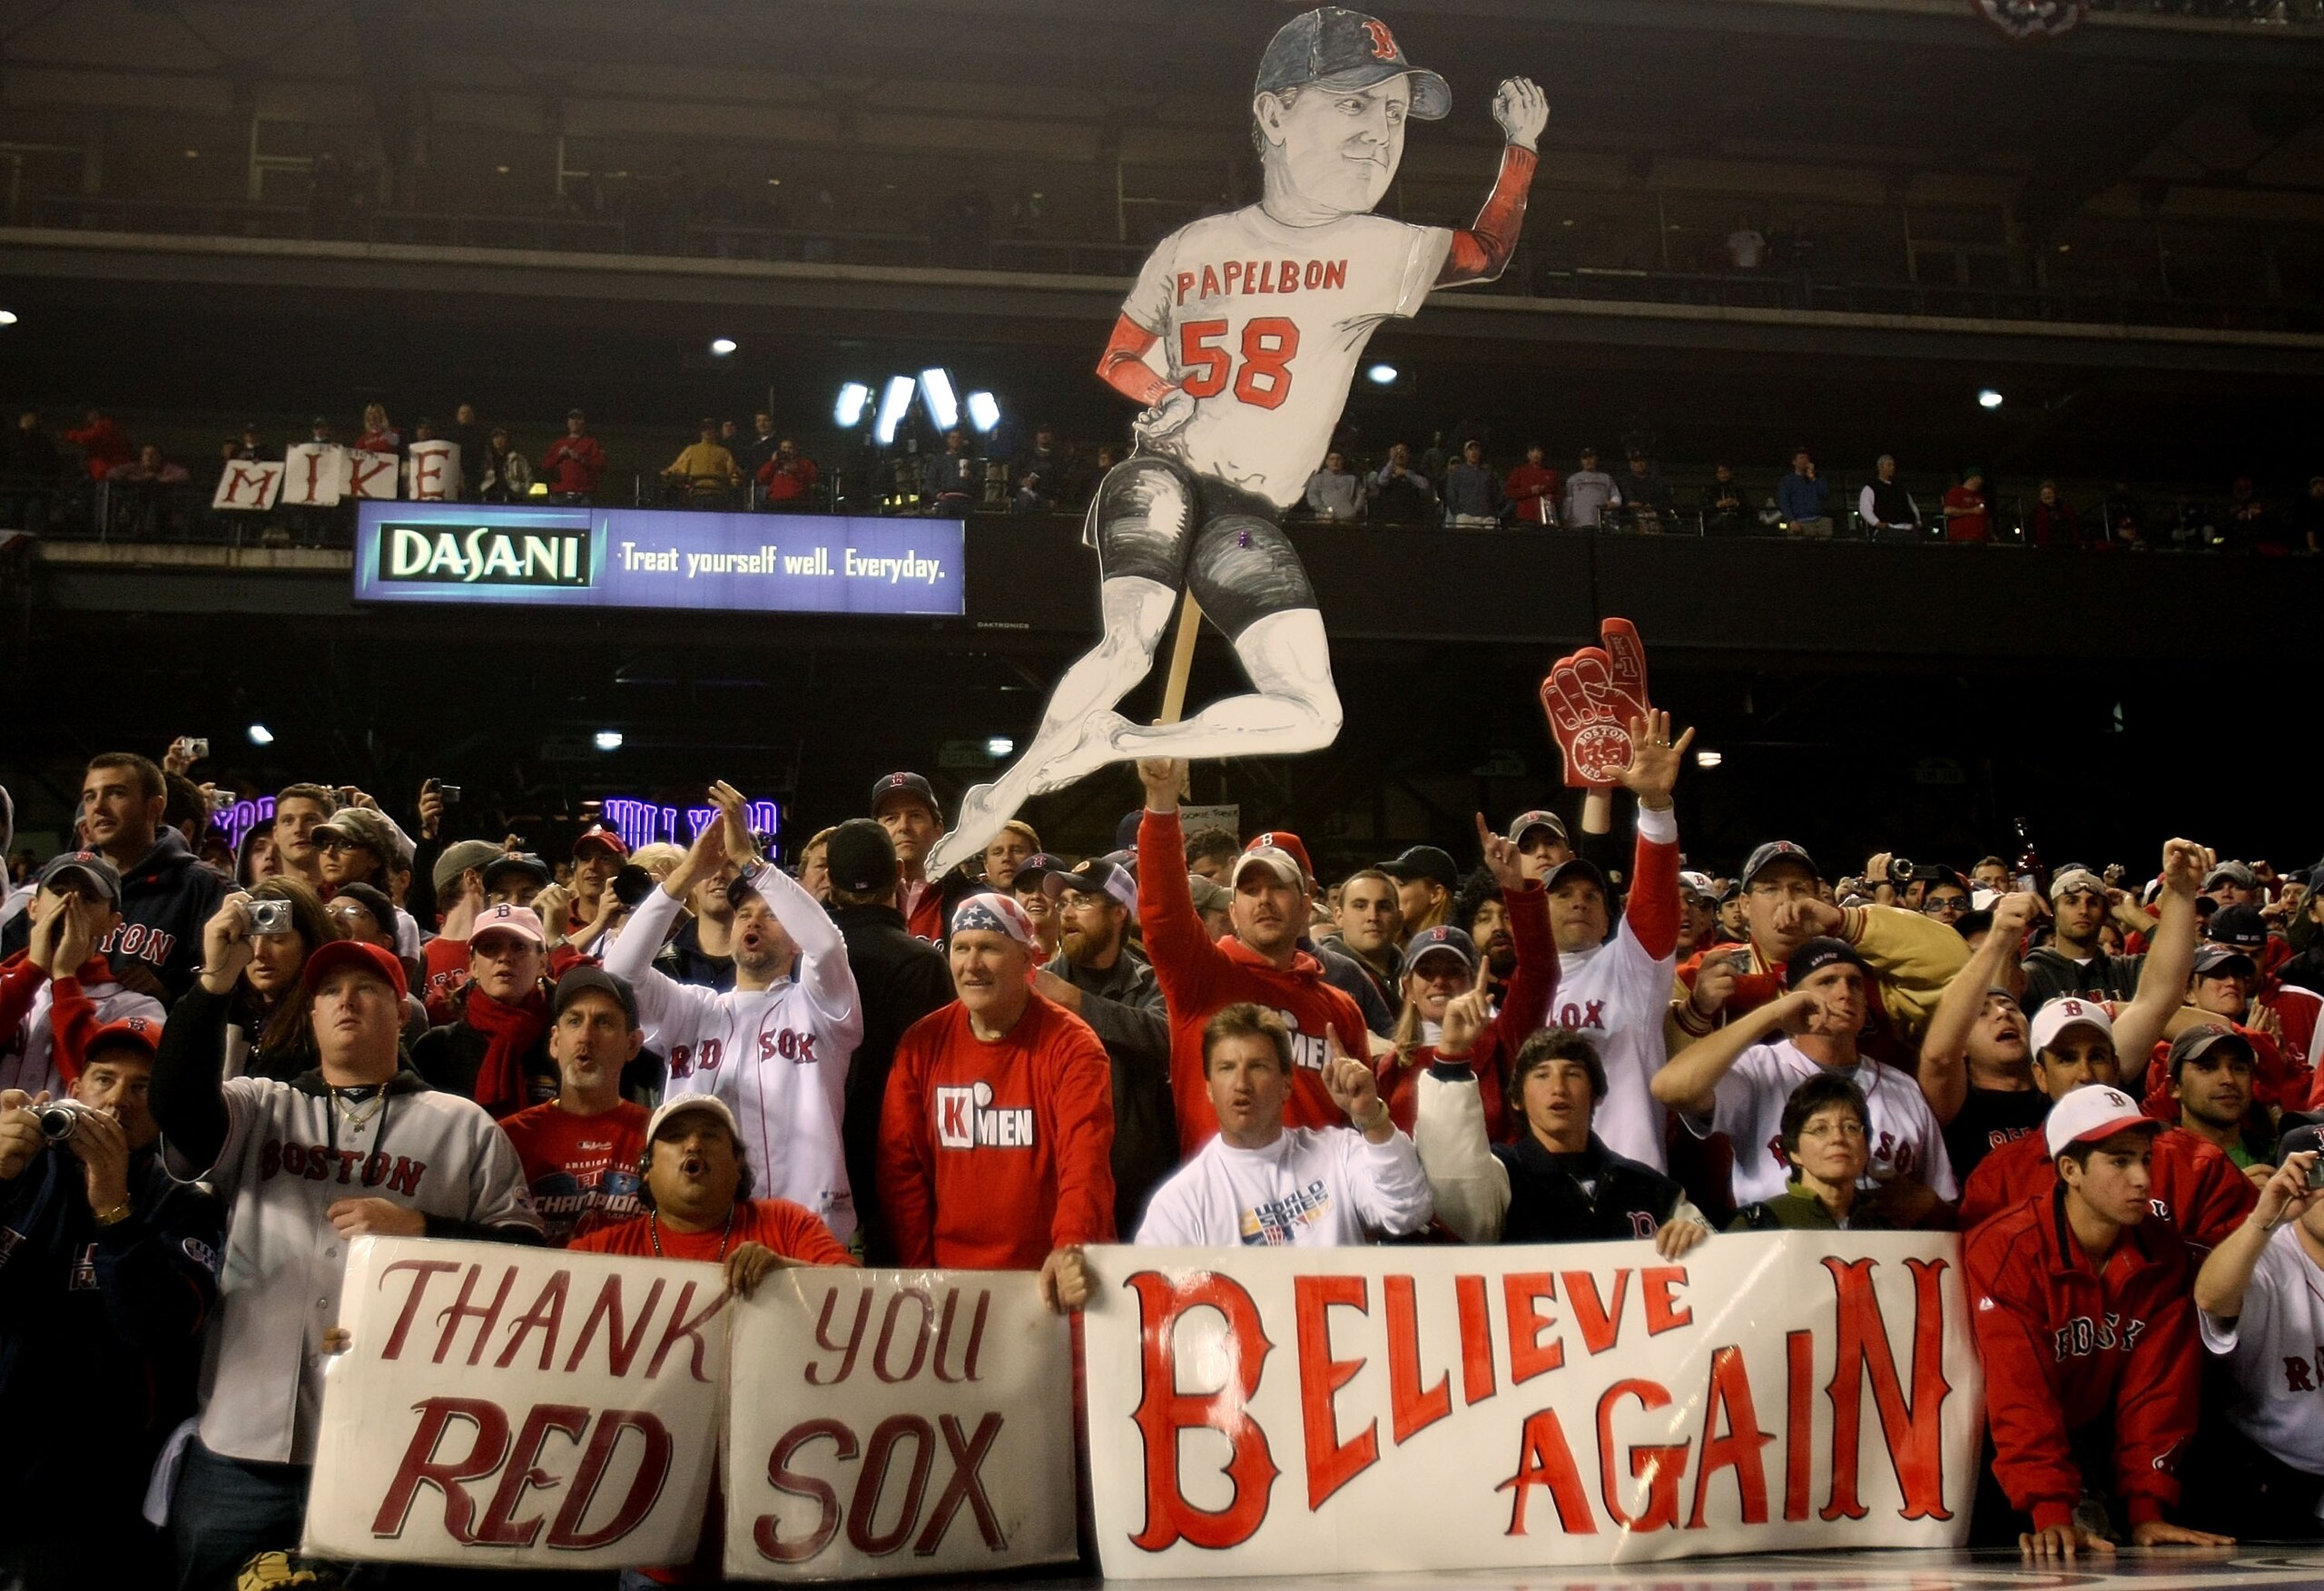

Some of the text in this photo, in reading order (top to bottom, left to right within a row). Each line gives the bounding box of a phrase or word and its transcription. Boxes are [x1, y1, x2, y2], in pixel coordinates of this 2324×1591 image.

[1362, 20, 1398, 60] B
[1177, 259, 1348, 307] PAPELBON
[1180, 317, 1300, 410] 58
[391, 526, 579, 582] DASANI
[622, 542, 945, 584] Treat yourself well. Everyday.
[1578, 727, 1627, 745] BOSTON
[1260, 832, 1273, 847] B
[495, 905, 510, 919] B
[2061, 1000, 2083, 1016] B
[2104, 1091, 2125, 1107] B
[261, 1138, 427, 1198] BOSTON
[379, 1259, 733, 1384] THANK
[804, 1286, 990, 1386] YOU
[1123, 1265, 1694, 1553] BELIEVE
[1493, 1255, 1955, 1536] AGAIN
[371, 1396, 675, 1548] RED
[753, 1410, 1007, 1564] SOX
